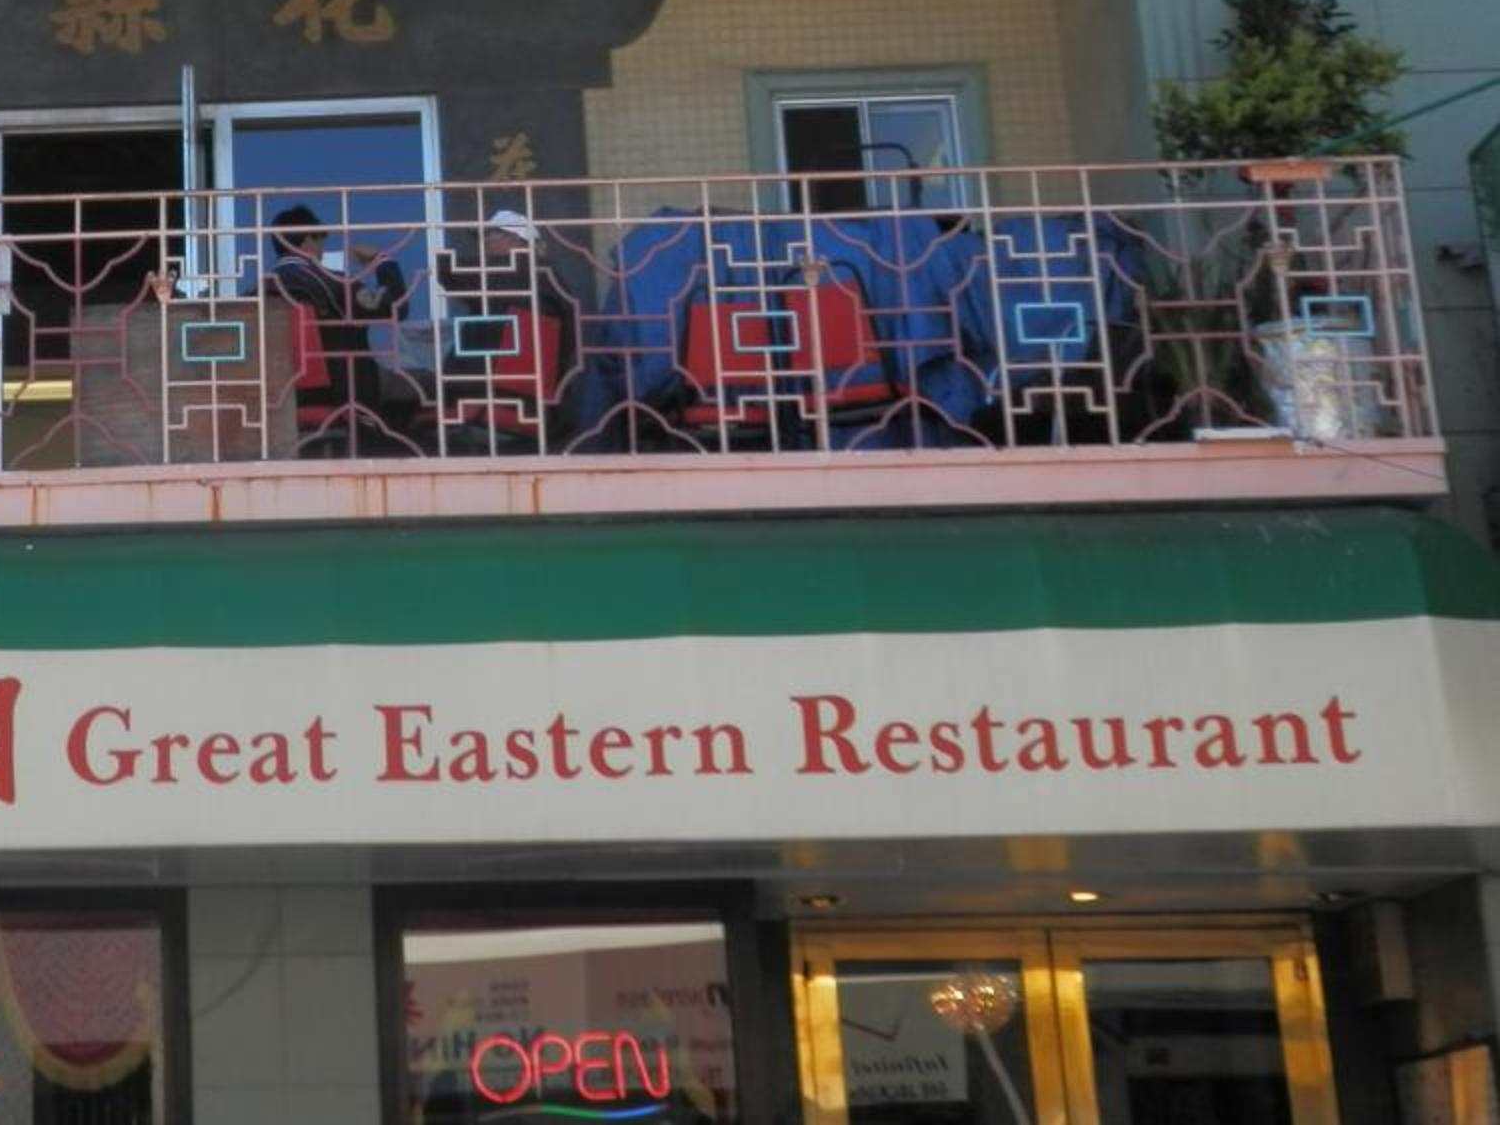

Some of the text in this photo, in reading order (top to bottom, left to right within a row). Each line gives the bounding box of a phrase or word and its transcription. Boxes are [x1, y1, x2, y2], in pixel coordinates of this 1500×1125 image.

[66, 693, 1363, 786] Great Eastern Restaurant
[470, 1029, 671, 1104] OPEN
